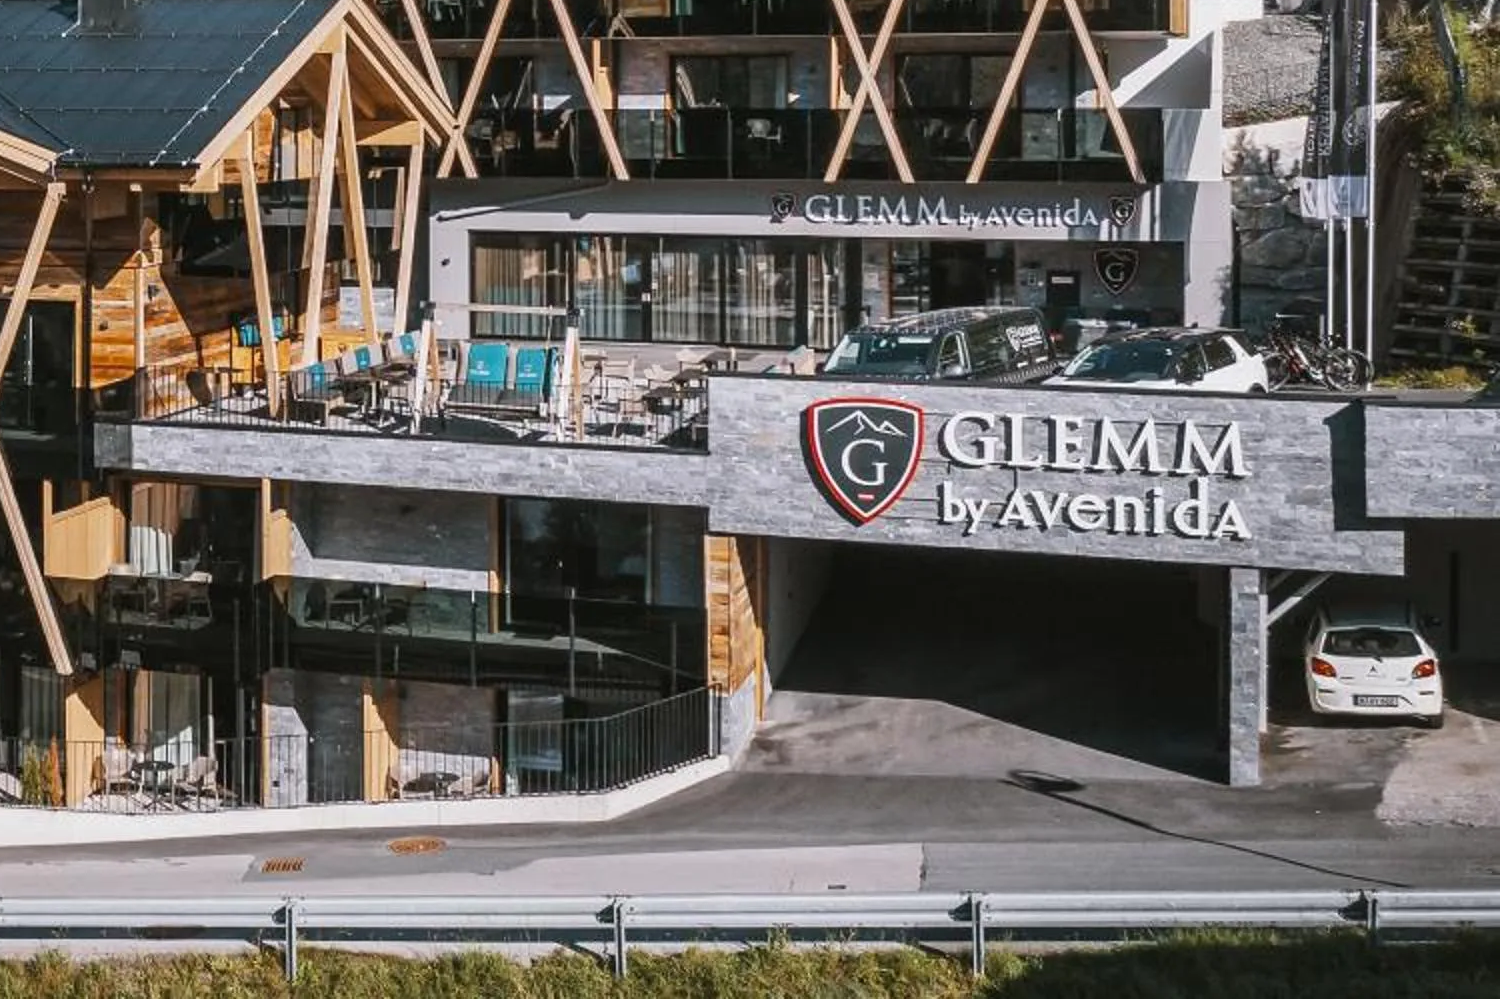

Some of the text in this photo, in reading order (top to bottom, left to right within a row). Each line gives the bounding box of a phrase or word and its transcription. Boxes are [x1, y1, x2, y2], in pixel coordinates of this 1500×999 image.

[805, 194, 952, 224] GLEMM
[959, 204, 981, 229] by
[1105, 262, 1125, 282] G
[841, 438, 888, 486] G
[943, 411, 1252, 477] GLEMM
[942, 480, 988, 534] by
